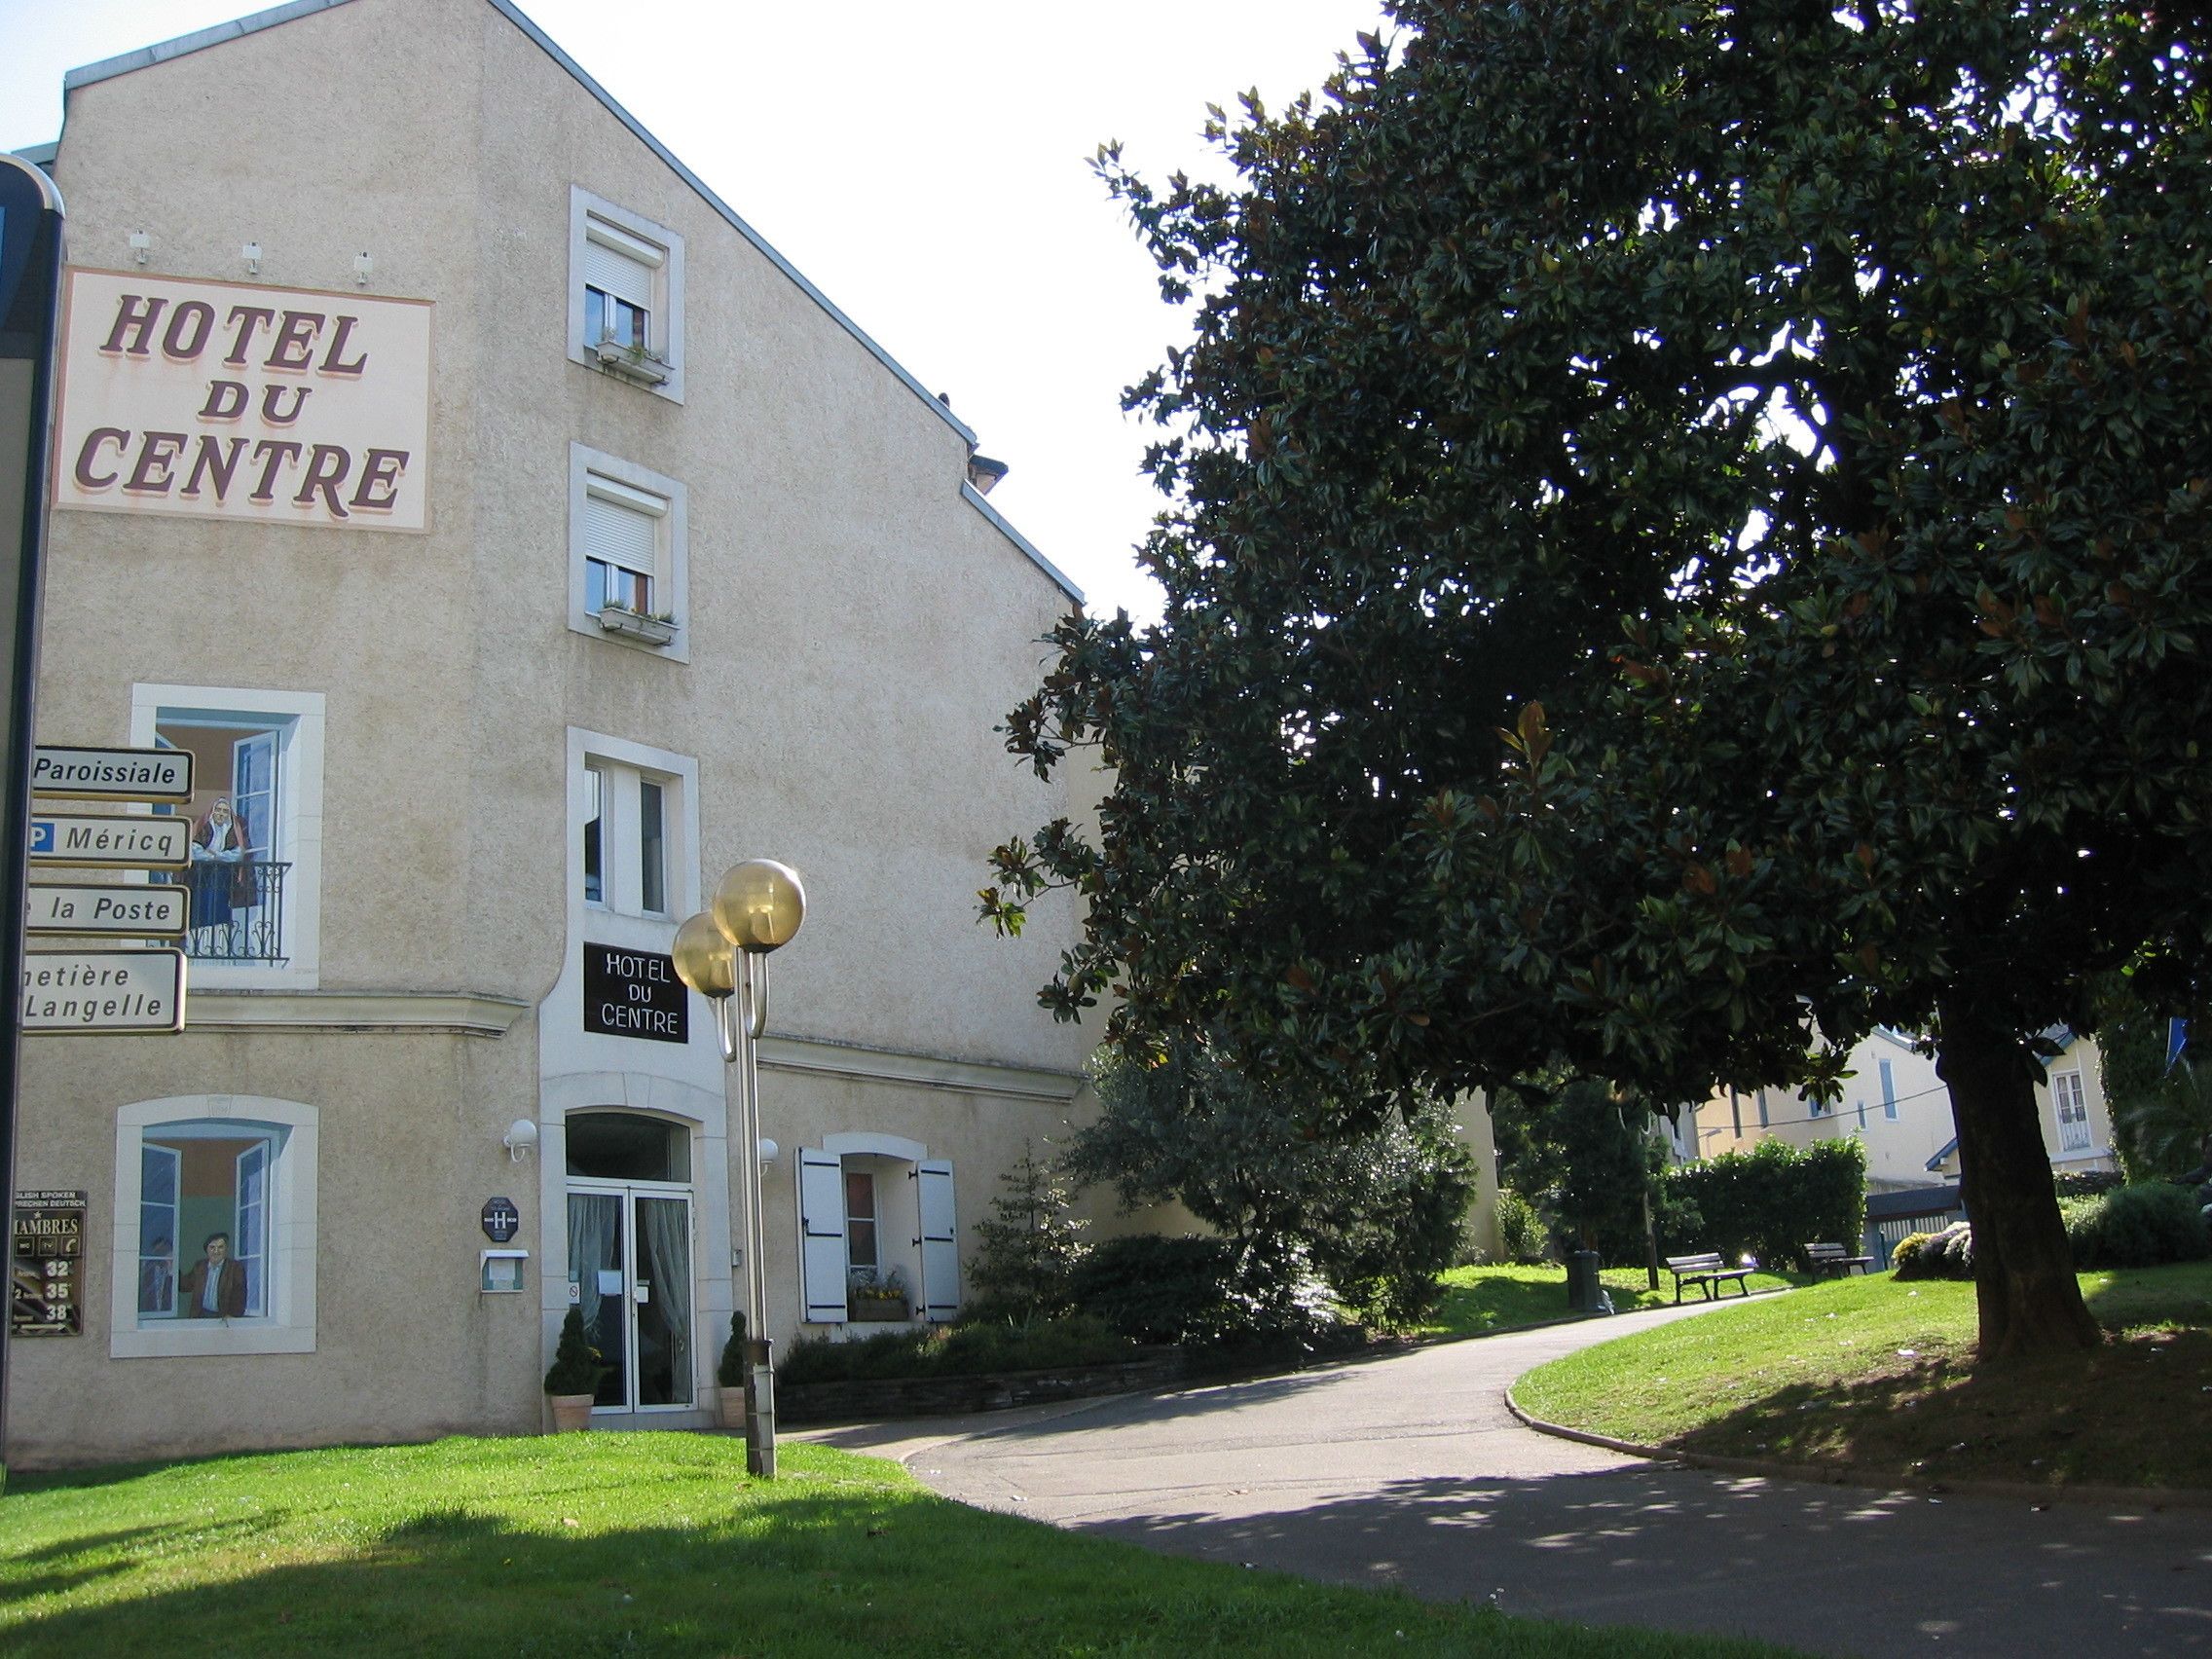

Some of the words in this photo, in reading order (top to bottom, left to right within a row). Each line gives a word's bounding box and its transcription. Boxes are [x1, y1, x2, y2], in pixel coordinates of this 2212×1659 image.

[99, 295, 369, 376] HOTEL
[198, 380, 313, 424] DU
[75, 427, 410, 518] CENTRE
[34, 757, 175, 784] Paroissiale
[67, 828, 172, 857] Méricq
[52, 897, 75, 918] la
[94, 898, 170, 920] Poste
[607, 953, 671, 983] HOTEL
[629, 983, 651, 1003] DU
[25, 994, 162, 1022] Langelle
[602, 1003, 679, 1034] CENTRE
